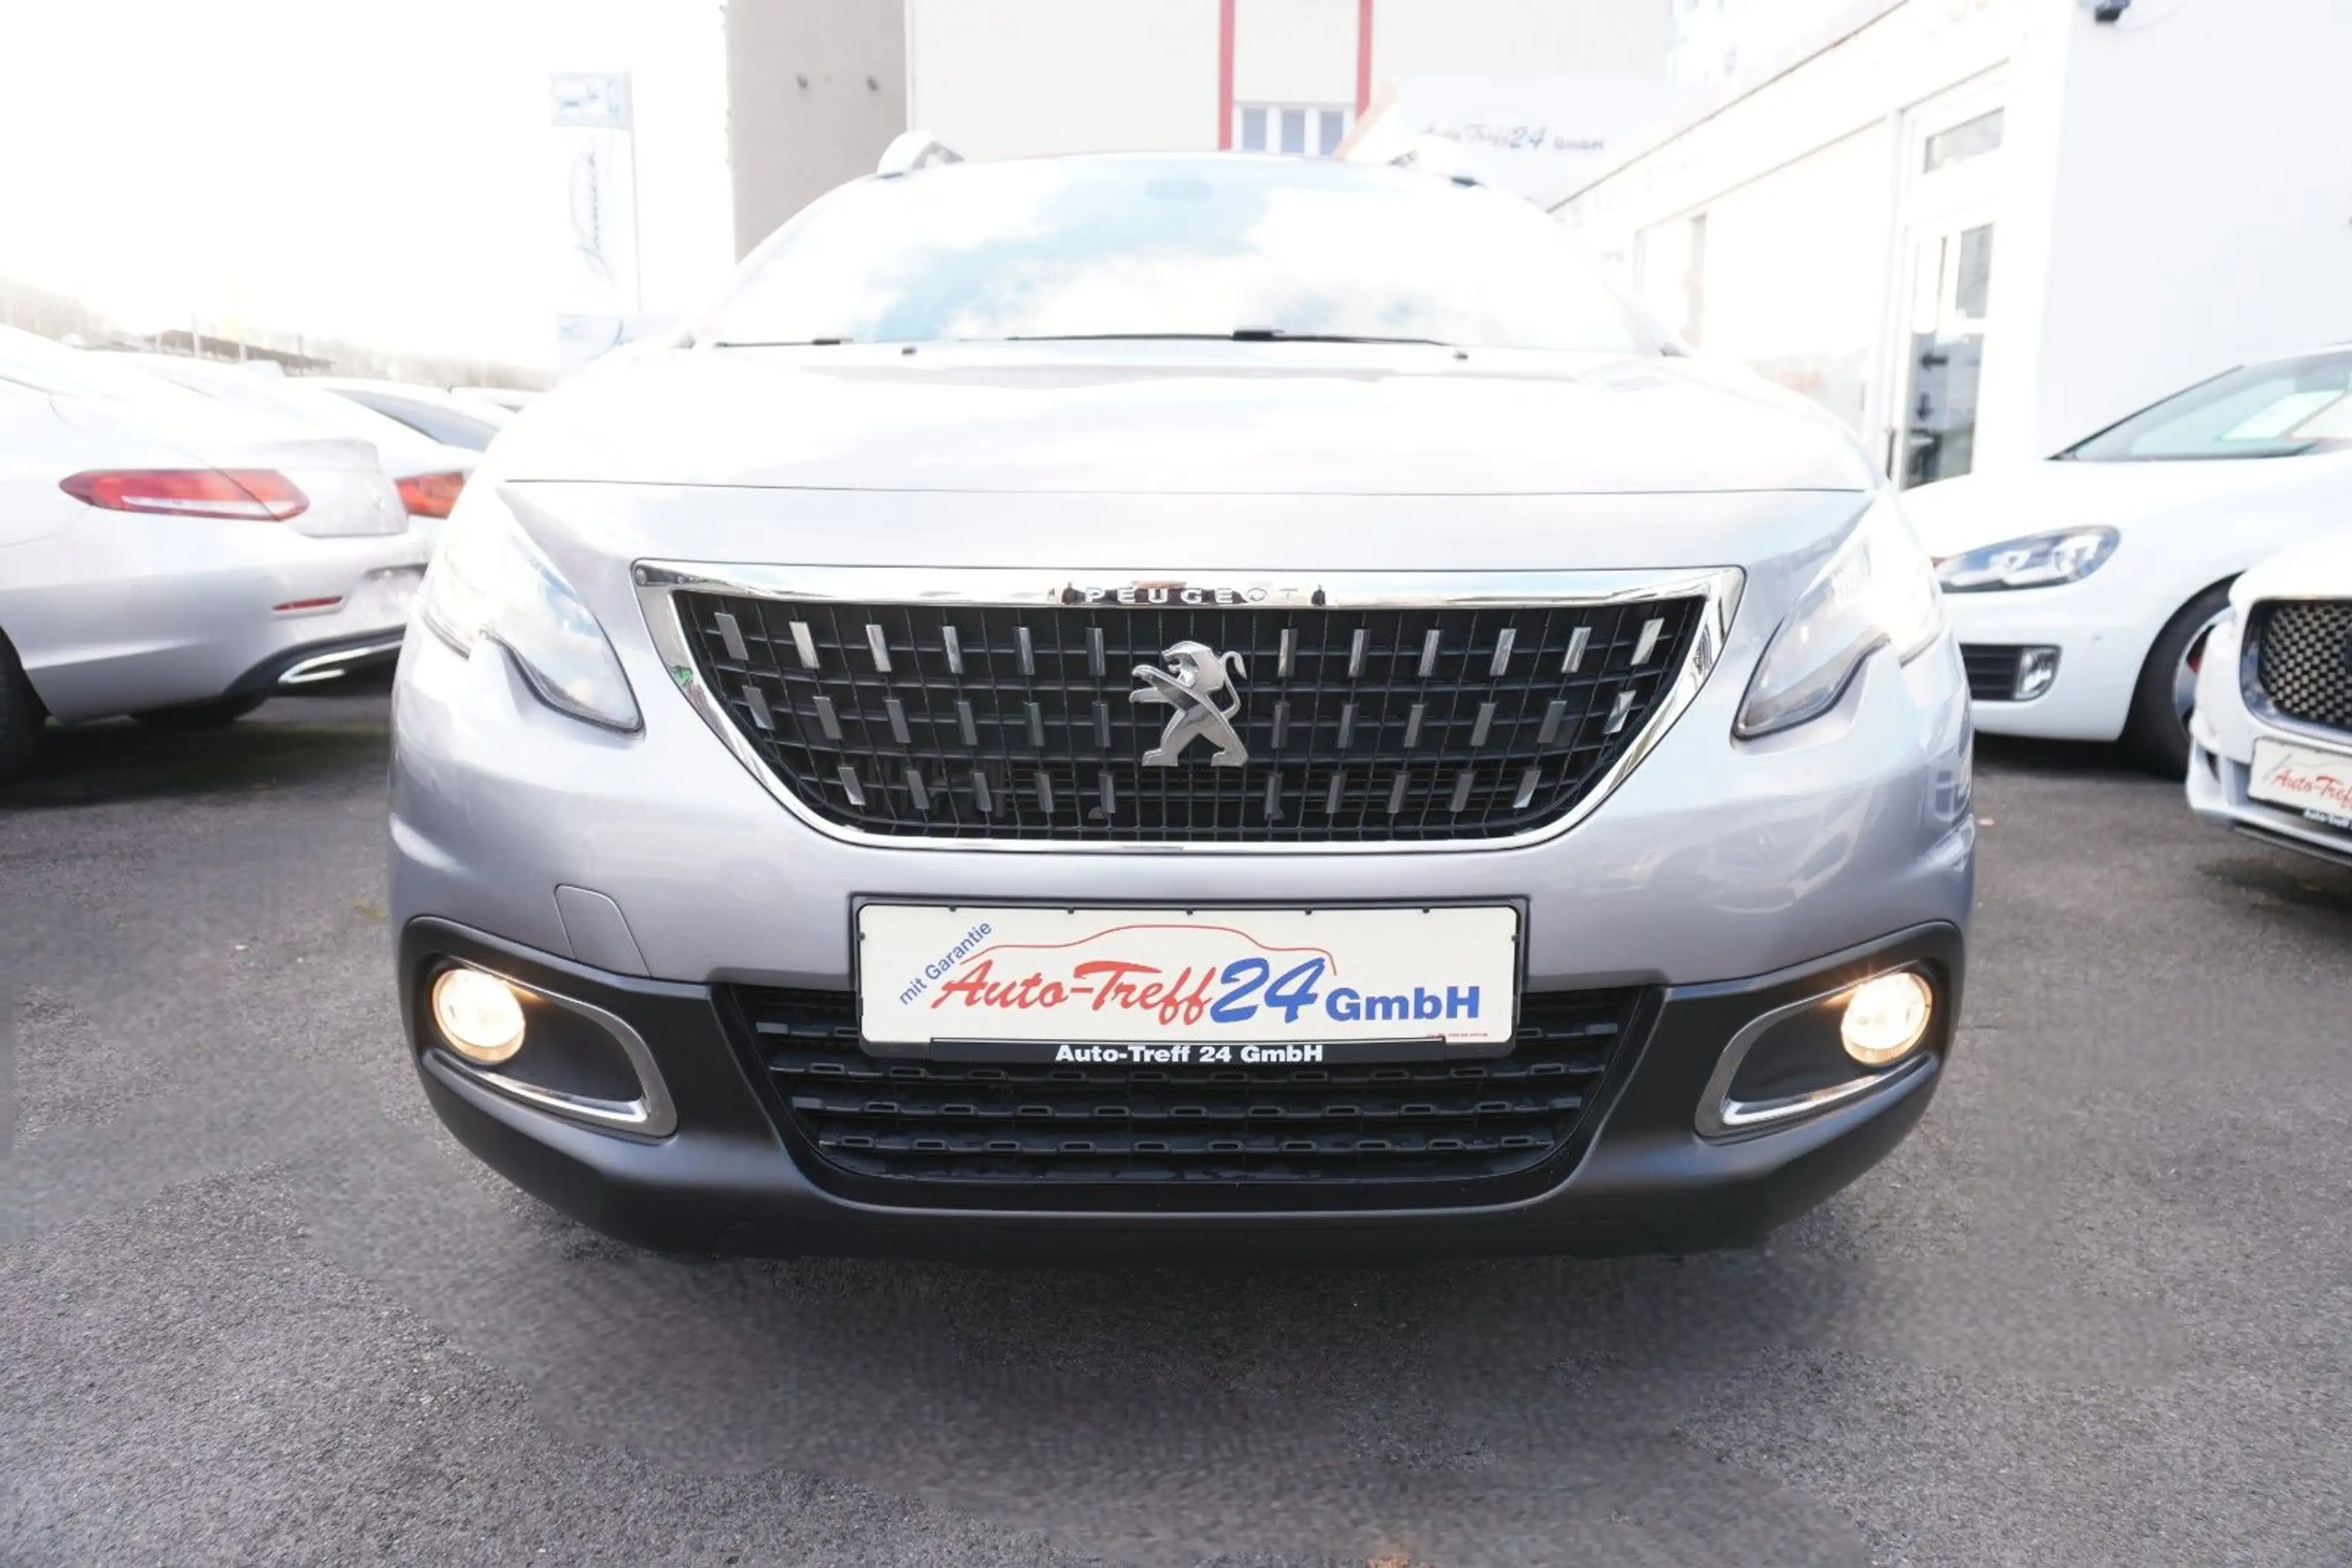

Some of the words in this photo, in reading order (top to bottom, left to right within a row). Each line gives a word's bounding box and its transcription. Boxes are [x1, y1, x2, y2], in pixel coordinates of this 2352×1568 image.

[1085, 587, 1300, 603] PEUGEOT
[899, 978, 927, 1005] mit
[924, 921, 992, 980] Garantie
[1325, 986, 1480, 1022] GmbH
[1055, 1045, 1190, 1062] Auto-Treff
[1199, 1046, 1232, 1062] 24
[1240, 1044, 1323, 1063] GmbH
